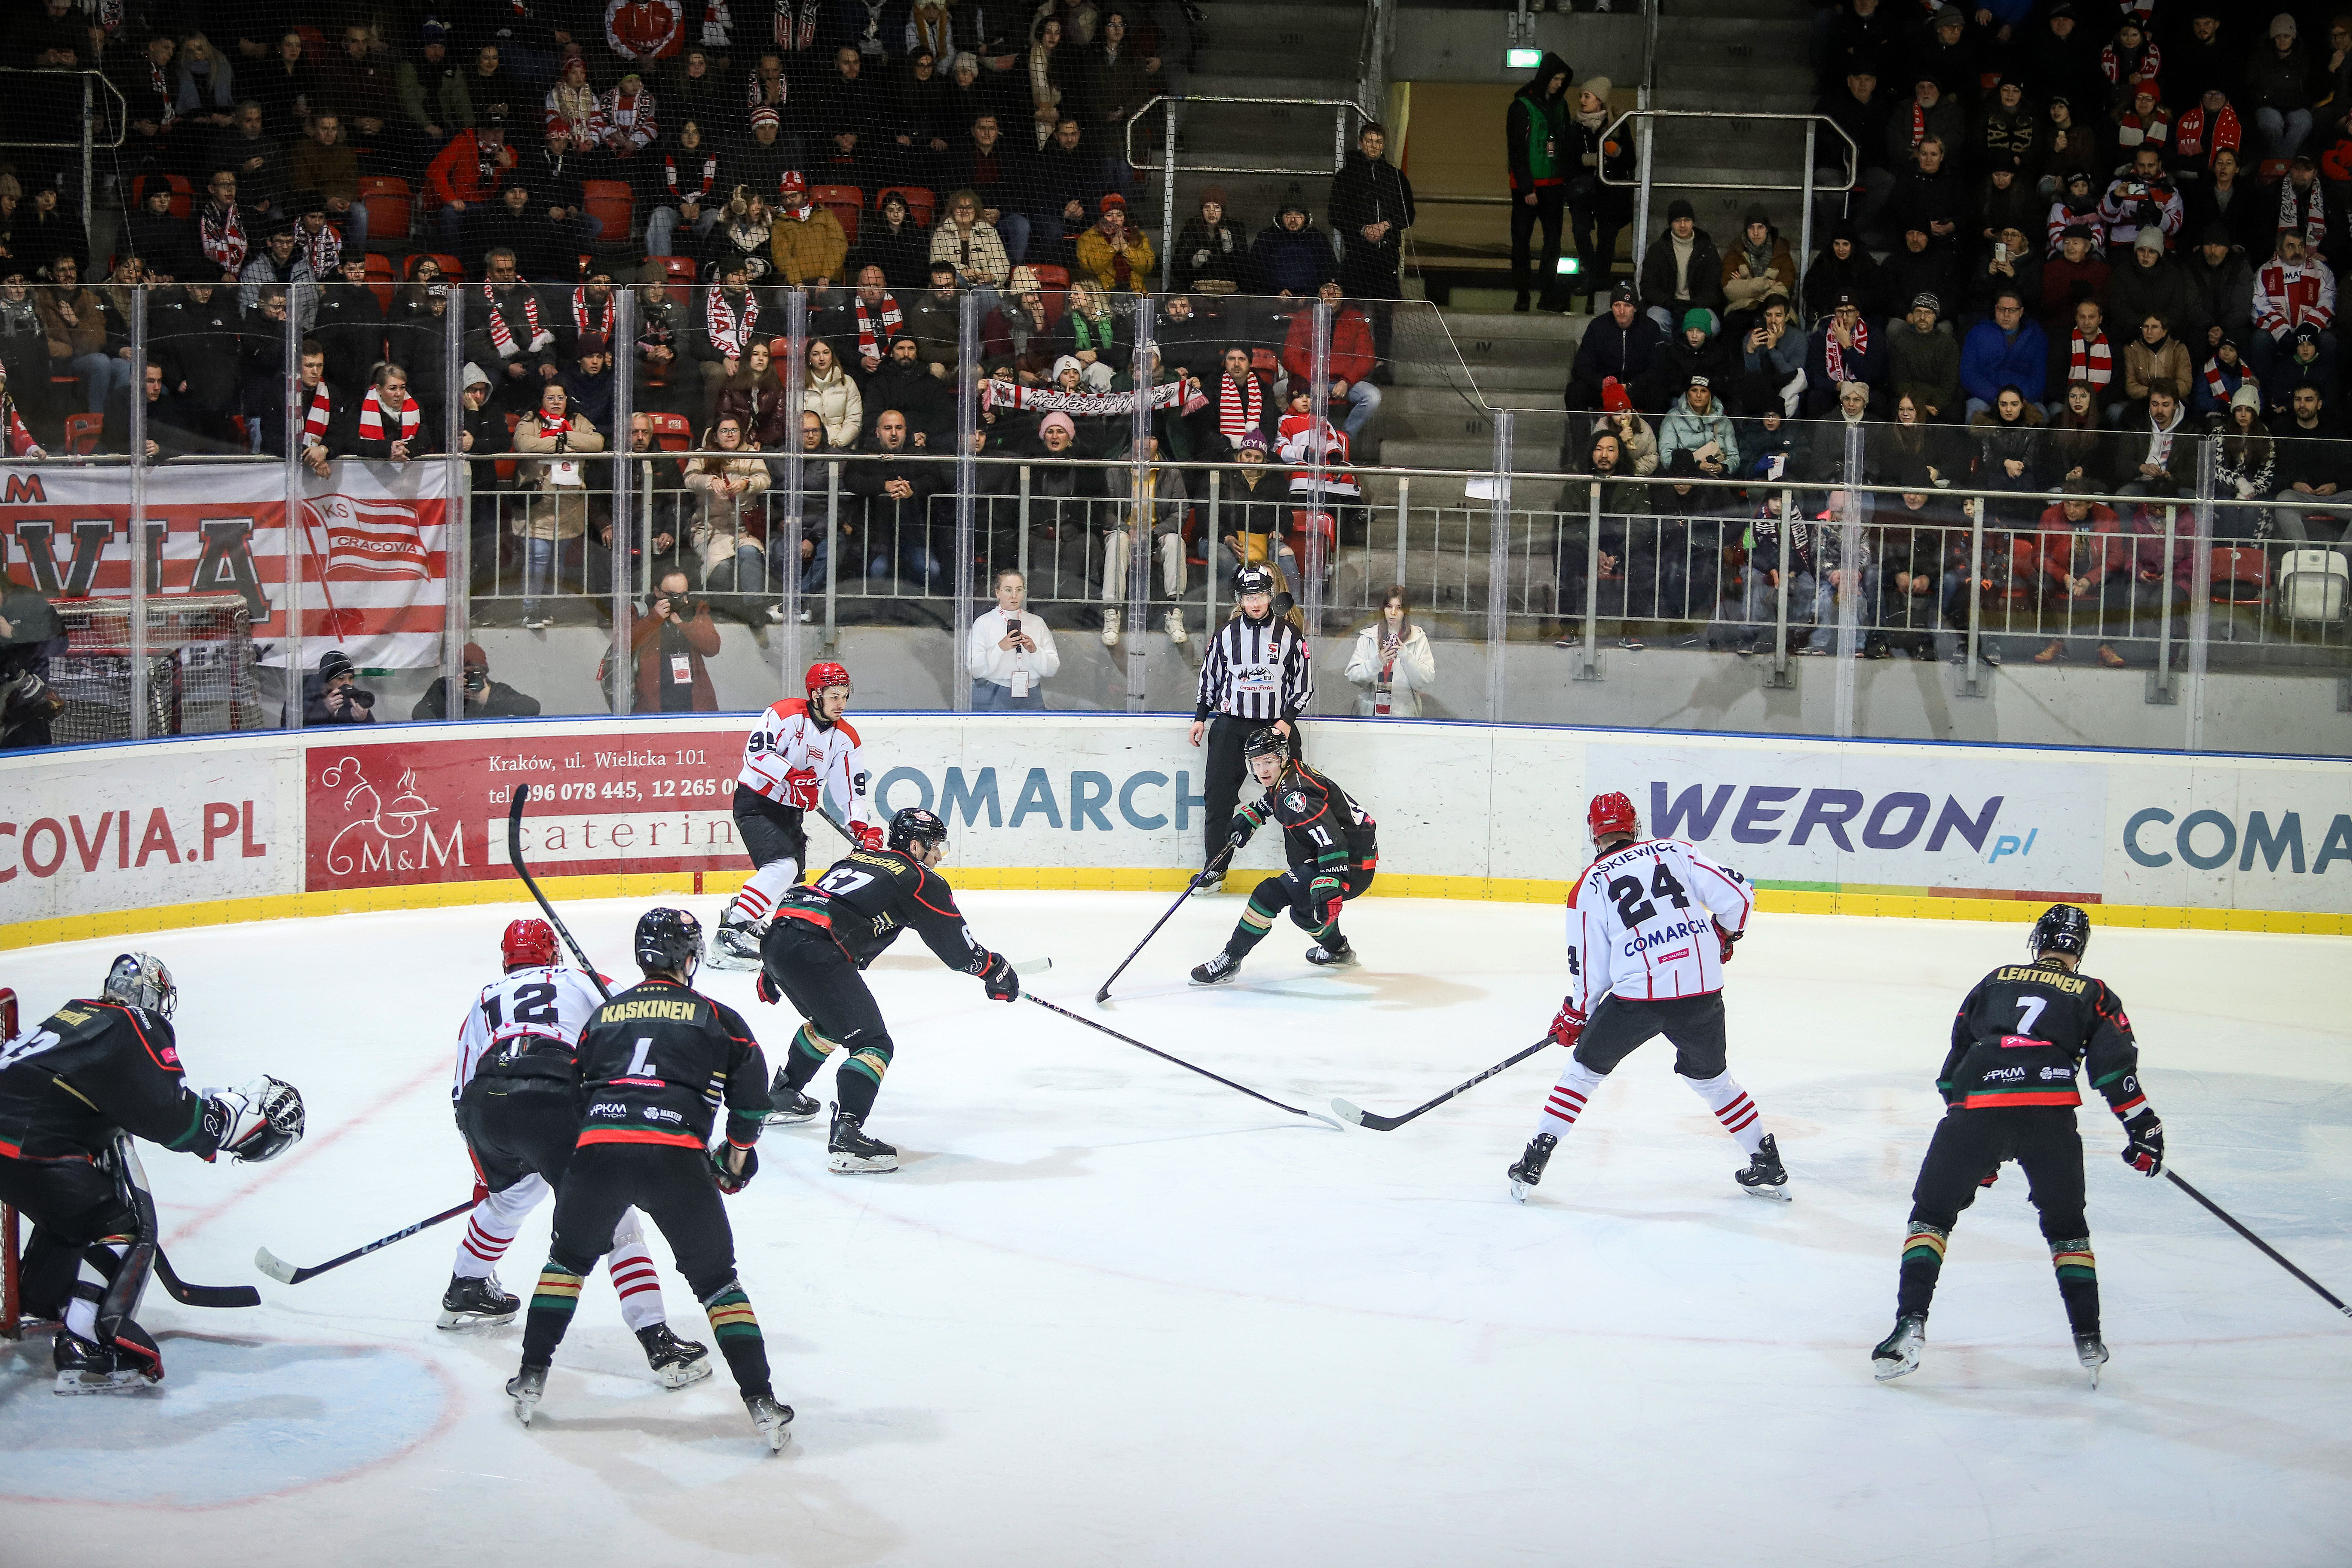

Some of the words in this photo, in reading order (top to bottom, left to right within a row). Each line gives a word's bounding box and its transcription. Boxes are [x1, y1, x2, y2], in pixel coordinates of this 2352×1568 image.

[1476, 341, 1491, 352] IV
[1026, 391, 1062, 409] TEAM
[1060, 394, 1116, 411] HOCKEY
[1115, 385, 1174, 412] CRAVIA
[323, 504, 349, 519] KS
[338, 536, 418, 554] CRACOVIA
[0, 517, 271, 624] VIA
[488, 755, 556, 773] Kraków,
[565, 752, 585, 769] ul.
[594, 749, 666, 767] Wielicka
[675, 749, 707, 765] 101
[561, 783, 596, 800] 078
[601, 780, 643, 802] 445,
[653, 779, 675, 798] 12
[680, 778, 717, 796] 265
[1651, 781, 2004, 854] WERON
[1988, 828, 2038, 864] pl
[360, 819, 471, 874] M&M
[1608, 864, 1691, 930] 24
[1624, 919, 1710, 958] COMARCH
[1997, 965, 2087, 995] LEHTONEN
[480, 983, 559, 1033] 12
[600, 999, 696, 1024] KASKINEN
[2015, 995, 2047, 1035] 7
[844, 1028, 861, 1040] BAUER
[1453, 1061, 1507, 1096] CCM
[1992, 1067, 2025, 1077] PKM
[596, 1103, 628, 1114] PKM
[660, 1109, 683, 1122] MASTER
[361, 1222, 423, 1254] CCM
